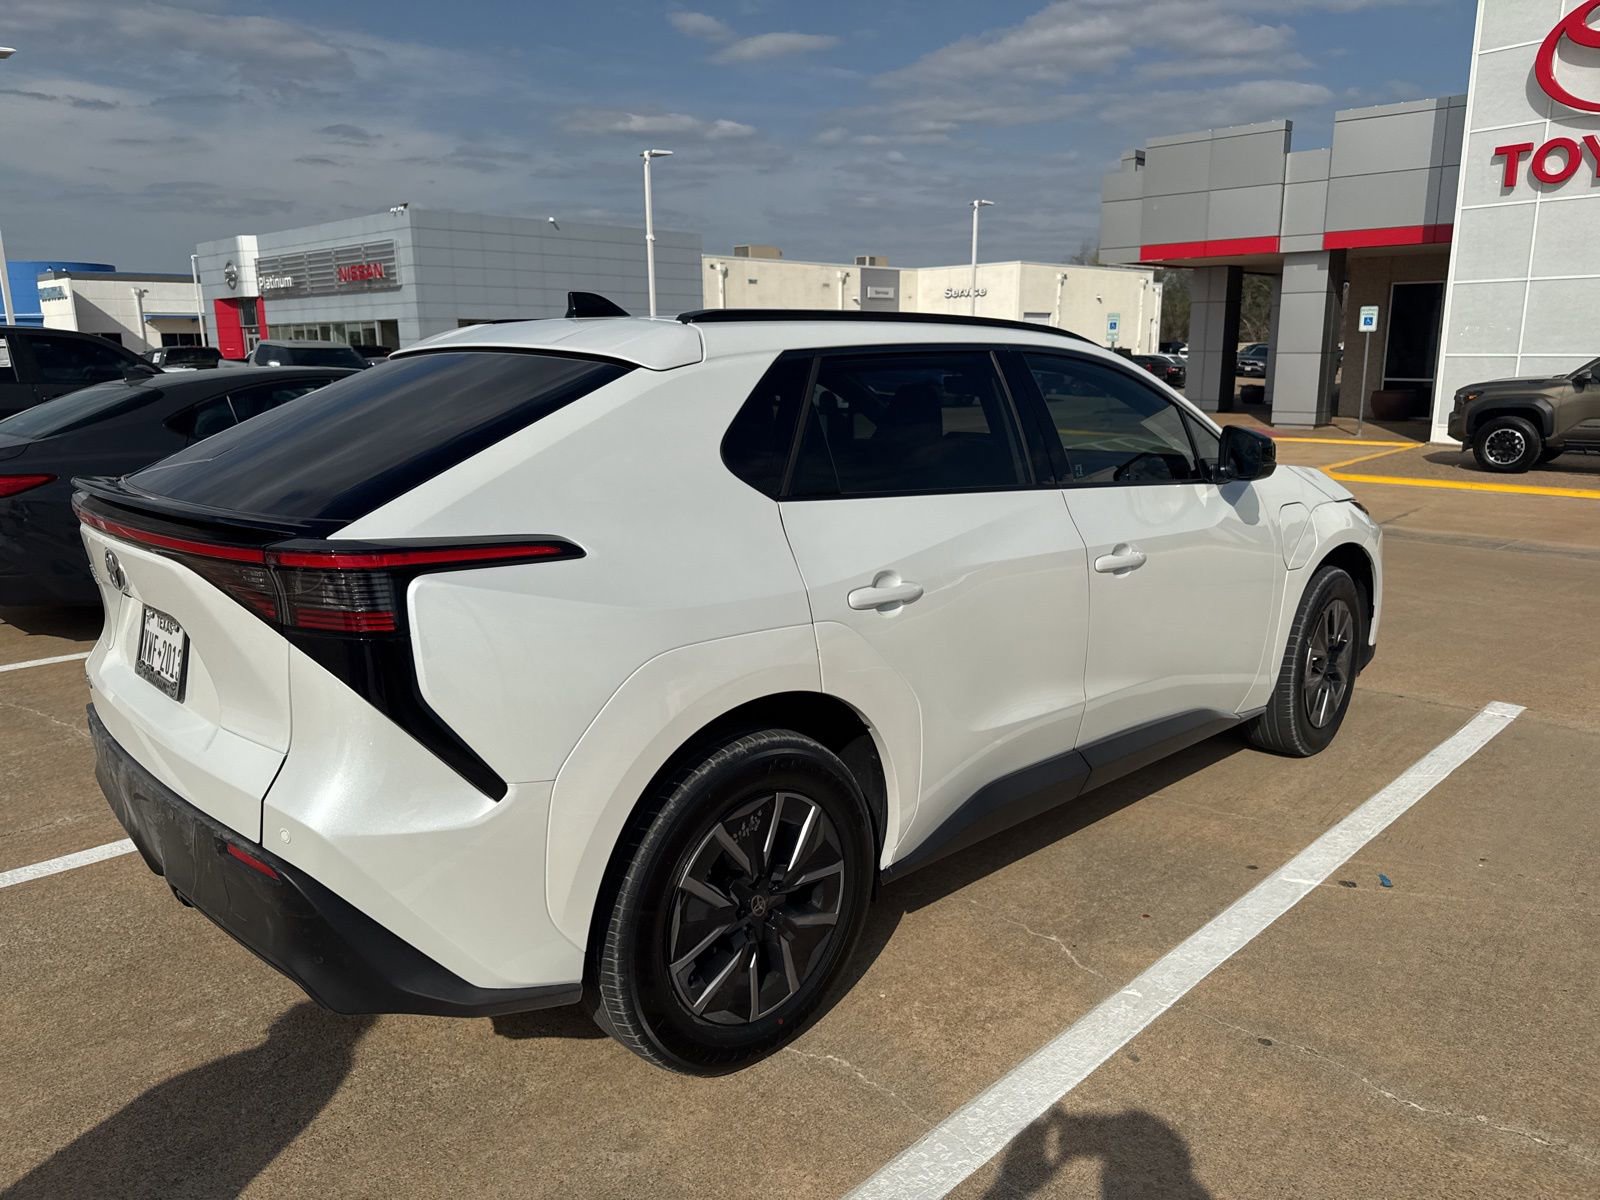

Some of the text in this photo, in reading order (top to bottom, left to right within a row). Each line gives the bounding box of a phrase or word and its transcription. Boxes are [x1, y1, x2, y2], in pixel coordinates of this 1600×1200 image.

[258, 276, 292, 290] Platinum
[338, 263, 386, 283] NISSAN
[157, 614, 174, 636] TEXAS
